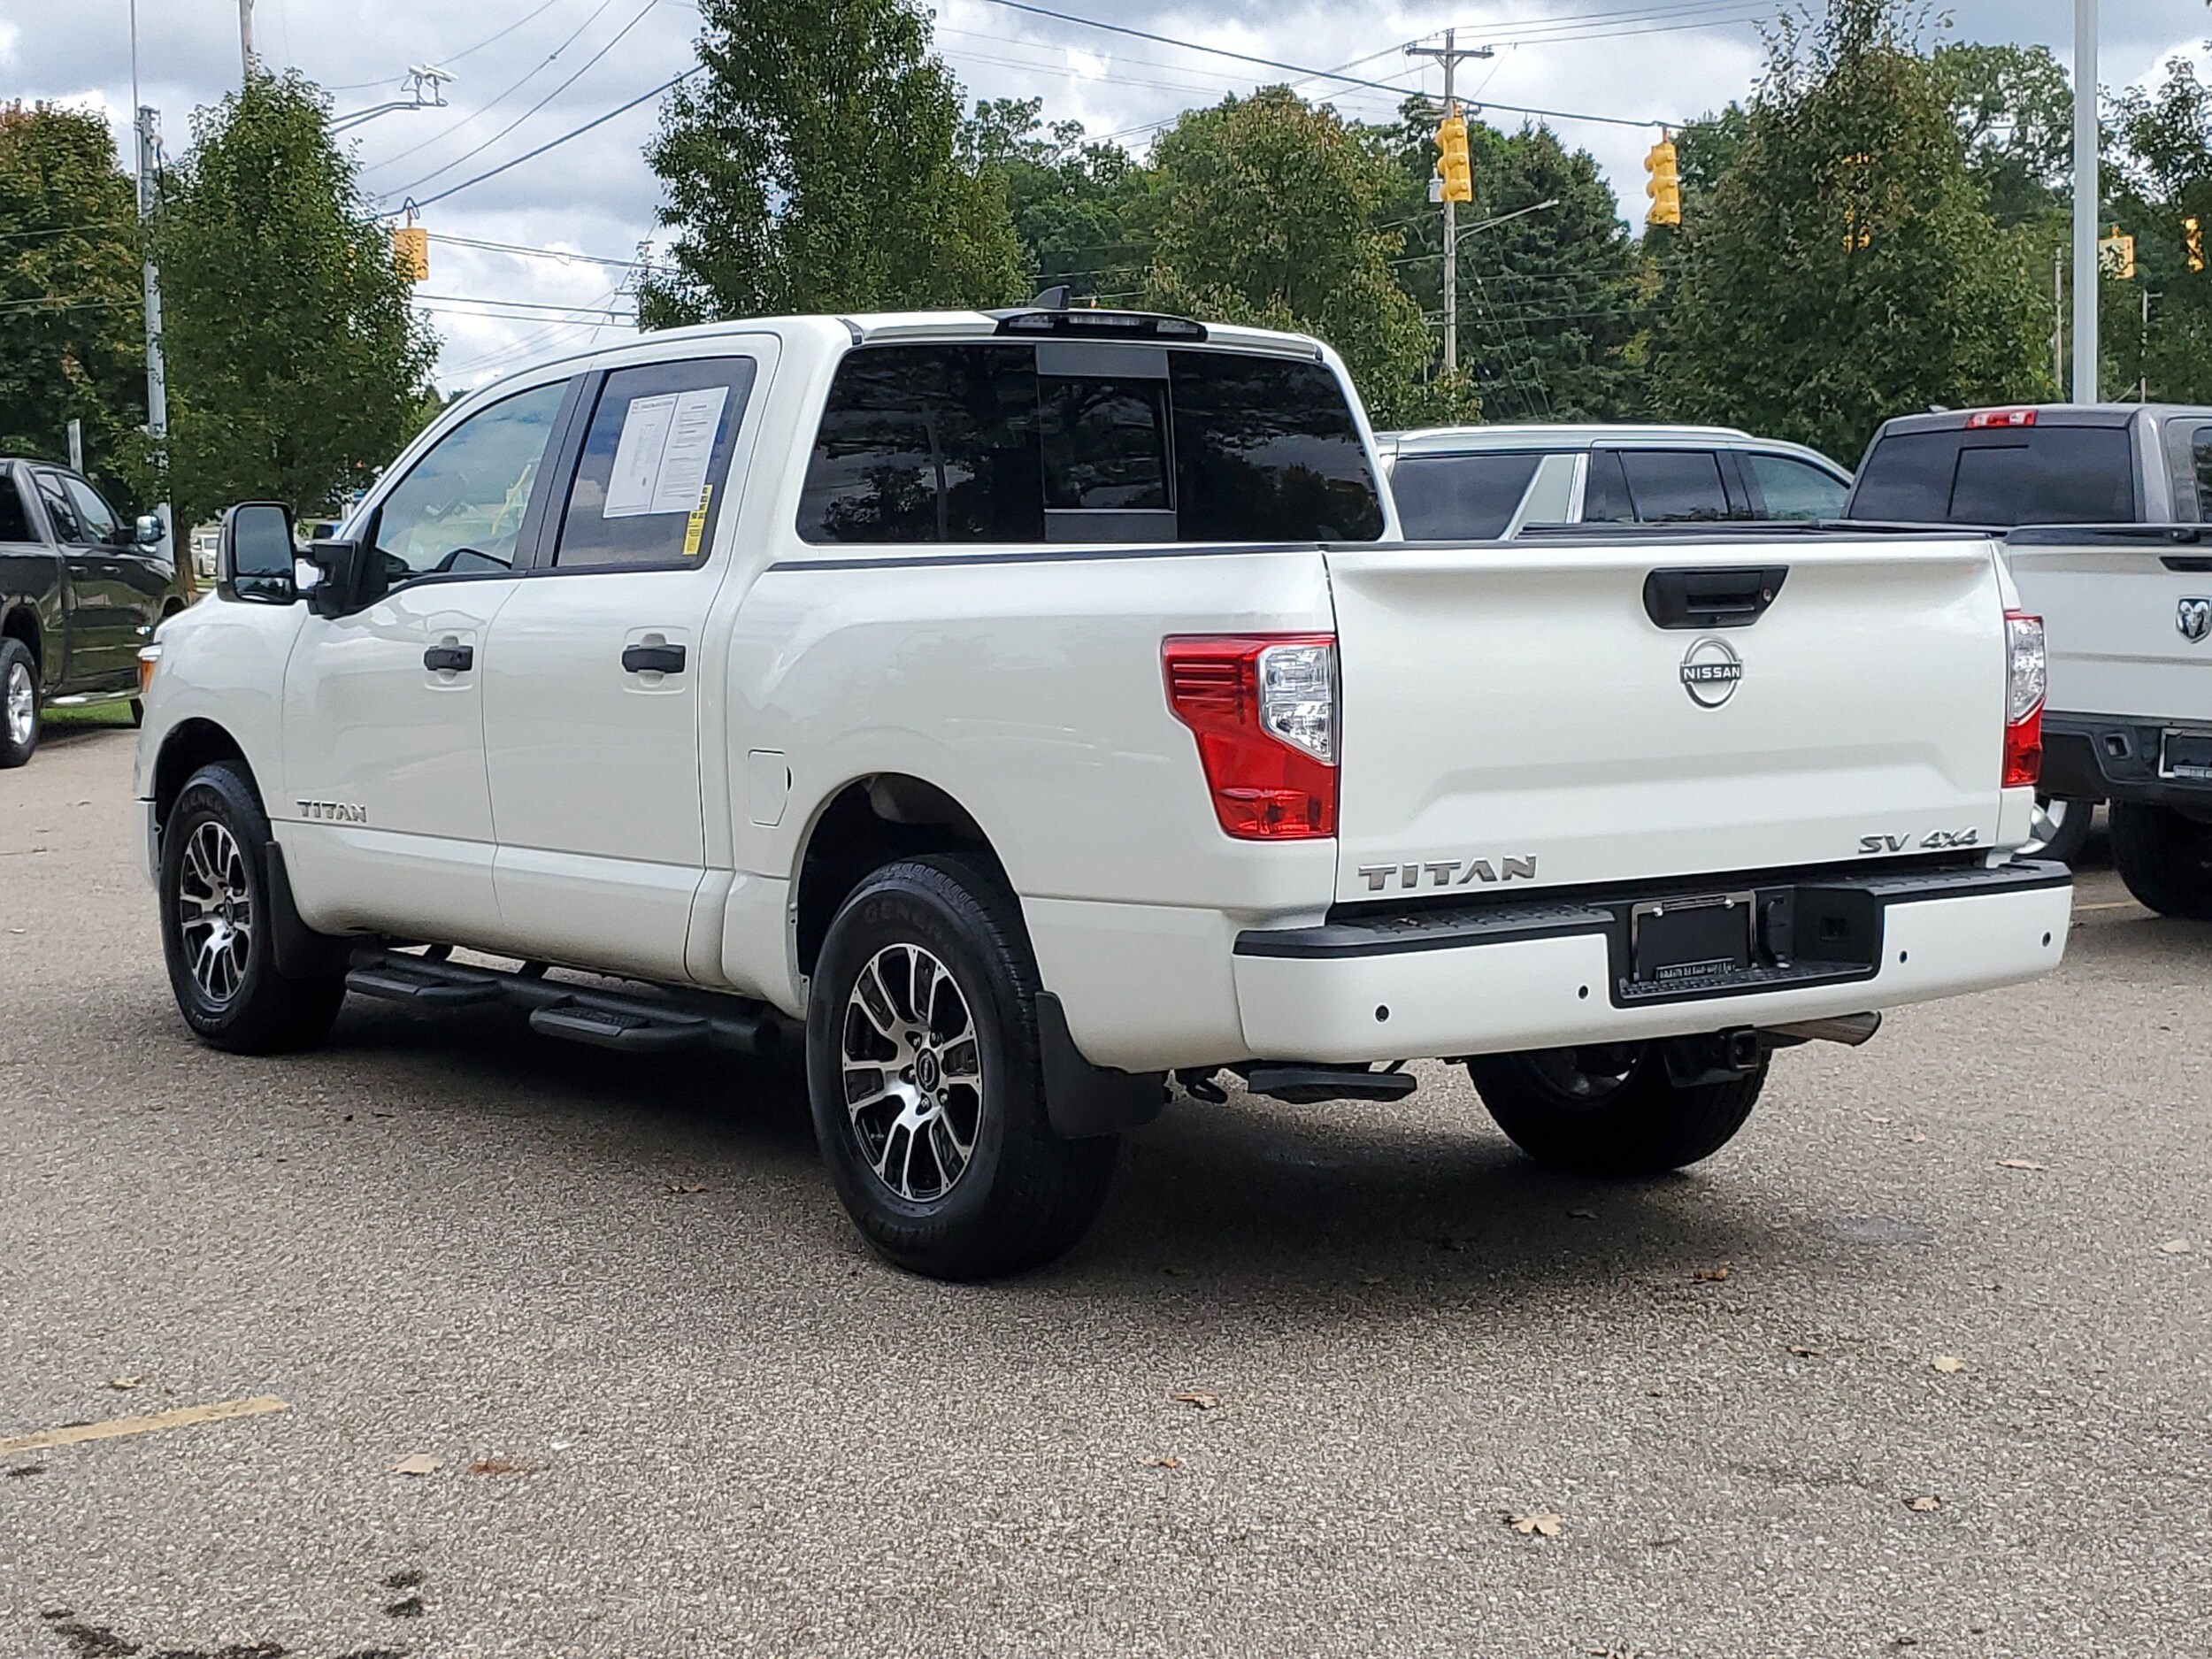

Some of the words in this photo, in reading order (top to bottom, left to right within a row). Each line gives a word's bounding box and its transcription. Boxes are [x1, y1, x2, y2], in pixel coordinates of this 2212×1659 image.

[1683, 666, 1740, 680] NISSAN
[296, 799, 367, 823] TITAN
[1858, 833, 1909, 854] SV
[1358, 854, 1537, 891] TITAN
